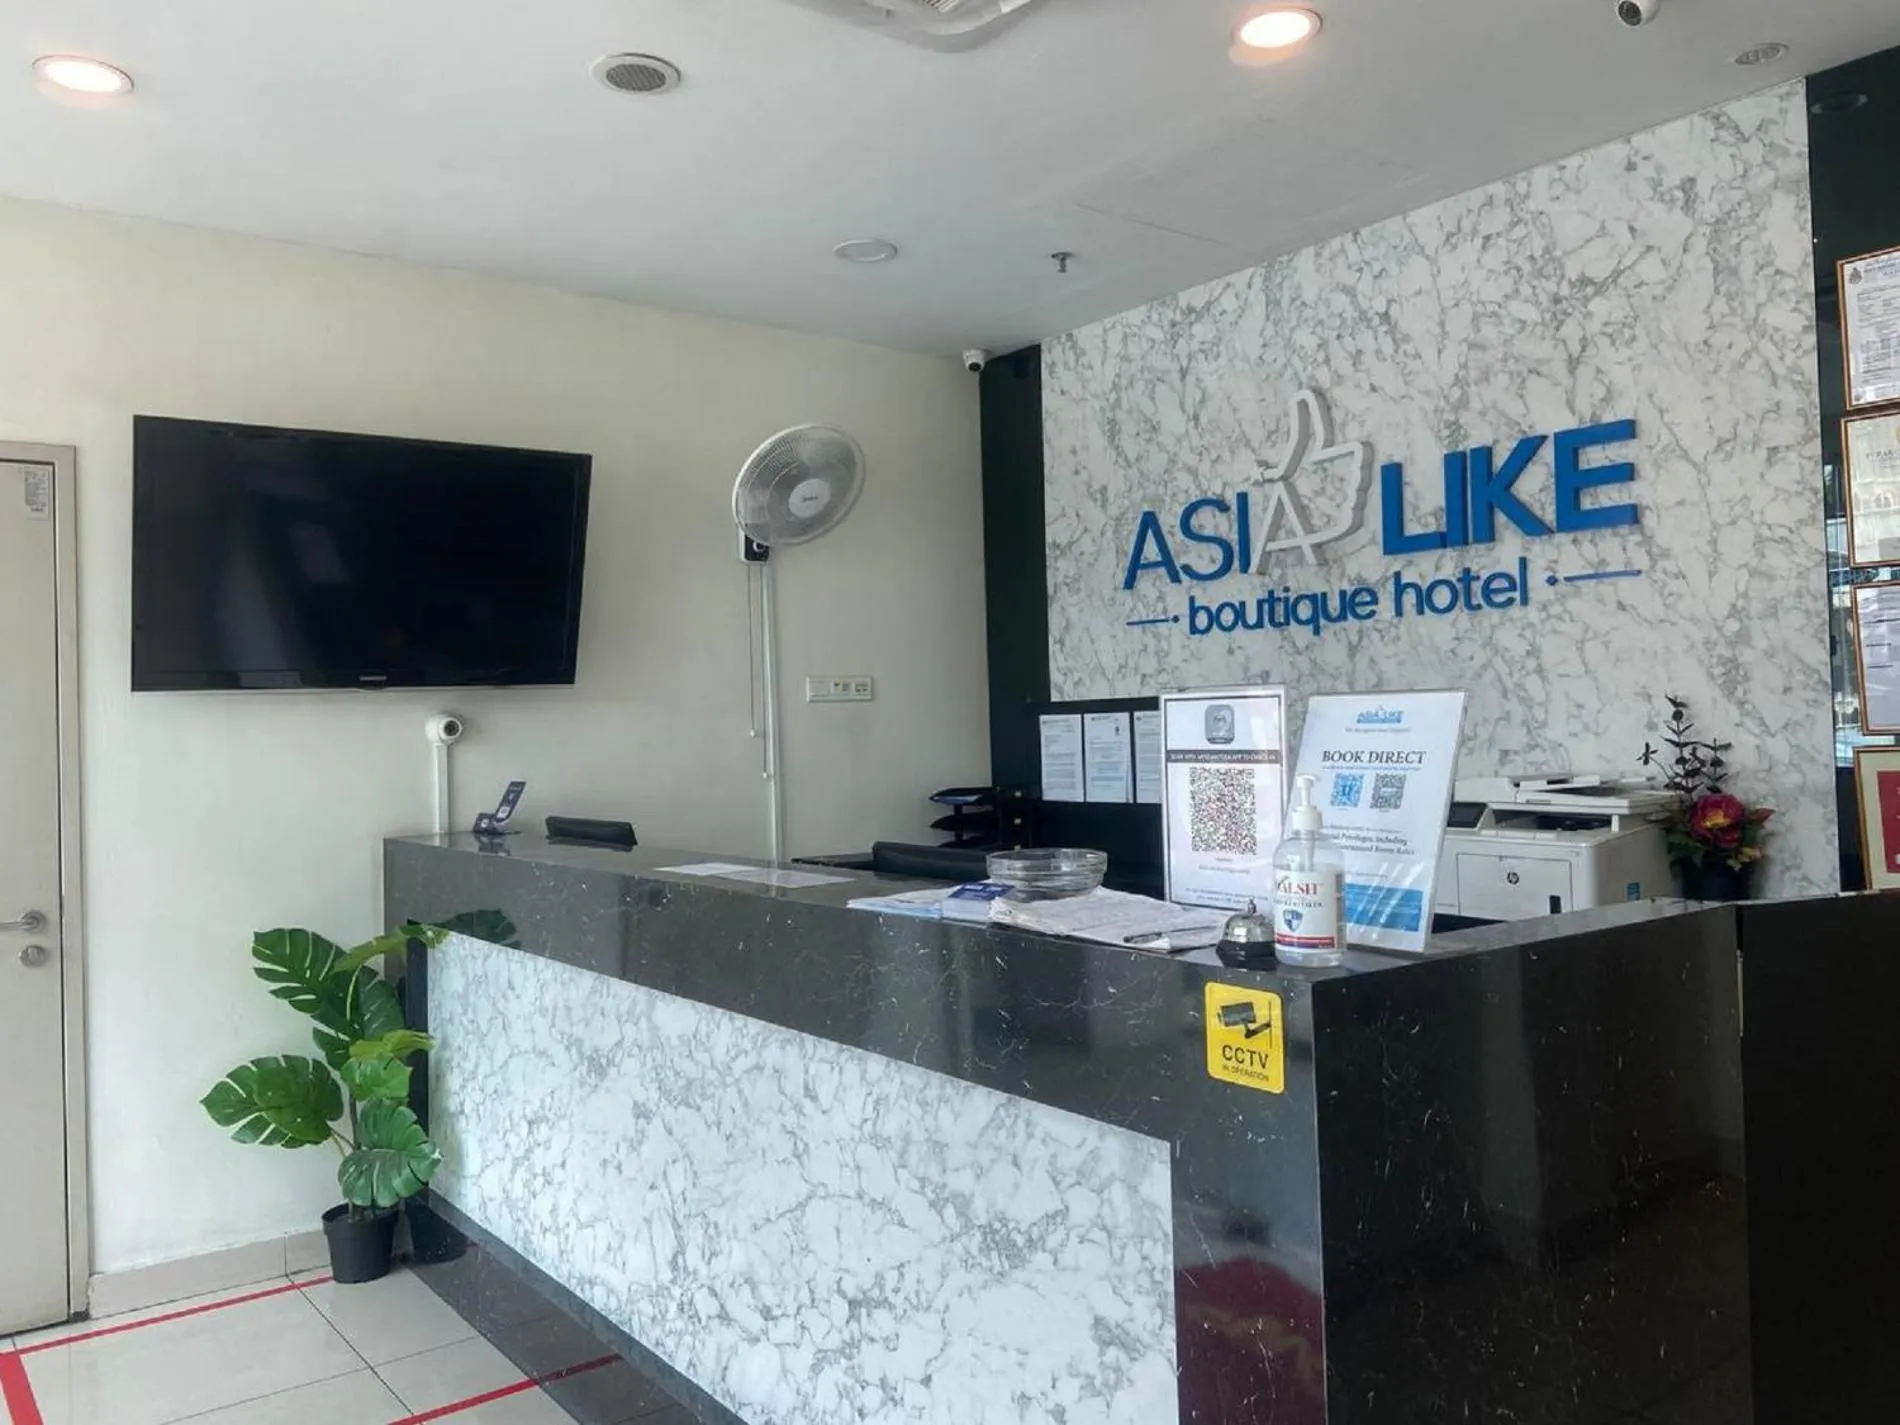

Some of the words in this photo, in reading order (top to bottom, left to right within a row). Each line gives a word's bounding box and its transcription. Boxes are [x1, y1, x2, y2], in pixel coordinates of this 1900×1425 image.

[1380, 418, 1639, 556] LIKE
[1188, 583, 1379, 636] boutique
[1394, 556, 1529, 619] hotel
[1321, 749, 1366, 763] BOOK
[1367, 750, 1426, 765] DIRECT
[1222, 1044, 1269, 1070] CCTV
